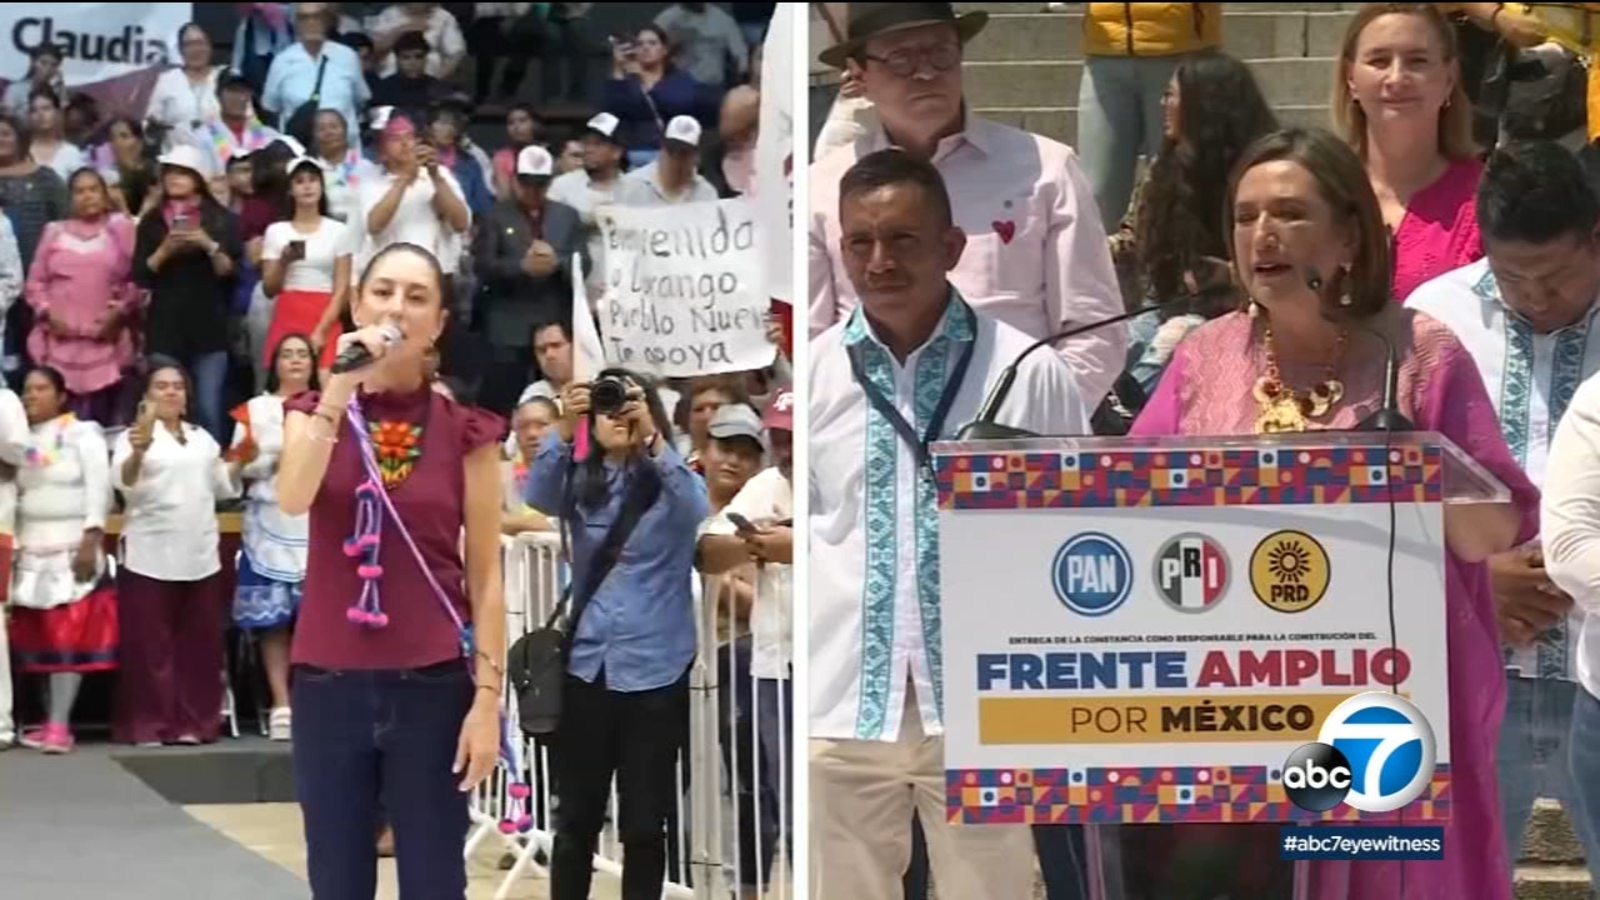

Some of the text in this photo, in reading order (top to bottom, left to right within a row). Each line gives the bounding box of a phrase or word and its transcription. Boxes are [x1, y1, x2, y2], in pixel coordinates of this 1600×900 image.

[12, 17, 170, 66] Claudia
[1067, 547, 1309, 602] PAN PRI PRD
[1009, 636, 1052, 645] ENTREGA
[1054, 636, 1067, 645] DE
[1069, 636, 1082, 645] LA
[1083, 635, 1143, 645] CONSTANCIA
[1145, 635, 1175, 644] COMO
[1175, 634, 1243, 643] RESPONSABLE
[1246, 634, 1272, 642] PARA
[1273, 634, 1287, 642] LA
[1358, 632, 1377, 640] DEL
[976, 649, 1411, 690] FRENTE AMPLIO
[1071, 700, 1315, 733] POR MÉXICO
